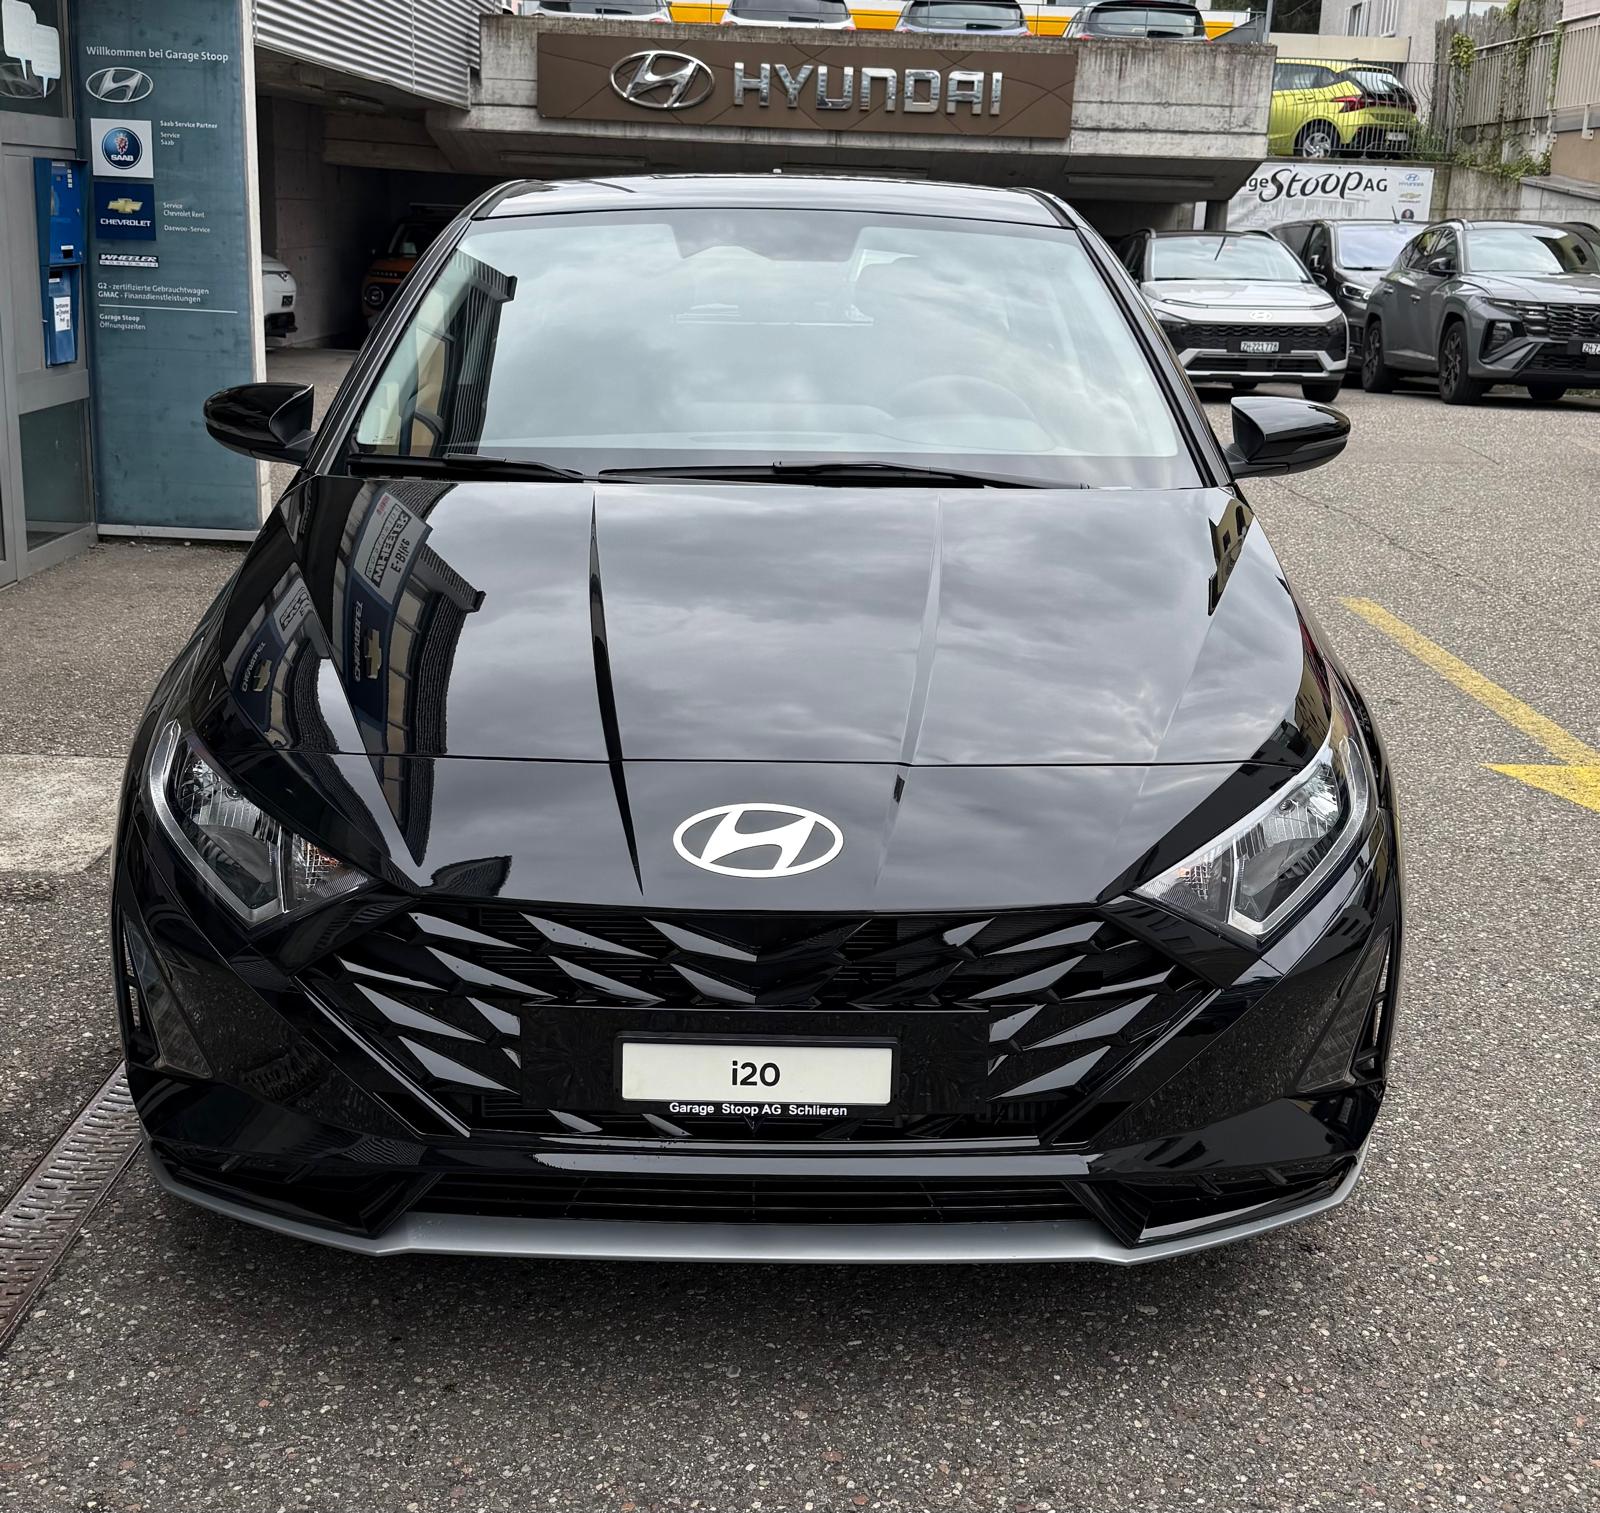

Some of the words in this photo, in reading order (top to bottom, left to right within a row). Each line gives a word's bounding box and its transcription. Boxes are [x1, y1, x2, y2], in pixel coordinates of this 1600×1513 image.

[86, 45, 147, 58] Willkommen
[149, 48, 163, 58] bei
[165, 49, 199, 62] Garage
[201, 51, 229, 63] Stoop
[733, 62, 1002, 115] HYUNDAI
[1363, 178, 1388, 192] AG
[163, 209, 191, 217] Chevrolet
[100, 218, 152, 227] CHEVROLET
[100, 254, 157, 262] WHEELER
[97, 282, 107, 290] G2
[112, 283, 151, 291] zertifizierte
[152, 284, 209, 296] Gebrauchtwagen
[98, 290, 119, 298] GMAC
[124, 292, 201, 304] Finanzdienstleistungen
[99, 313, 121, 322] Garage
[122, 314, 140, 322] Stoop
[731, 1060, 781, 1087] i20
[669, 1102, 715, 1115] Garage
[721, 1103, 759, 1116] Stoop
[762, 1103, 782, 1115] AG
[788, 1104, 848, 1116] Schlieren
